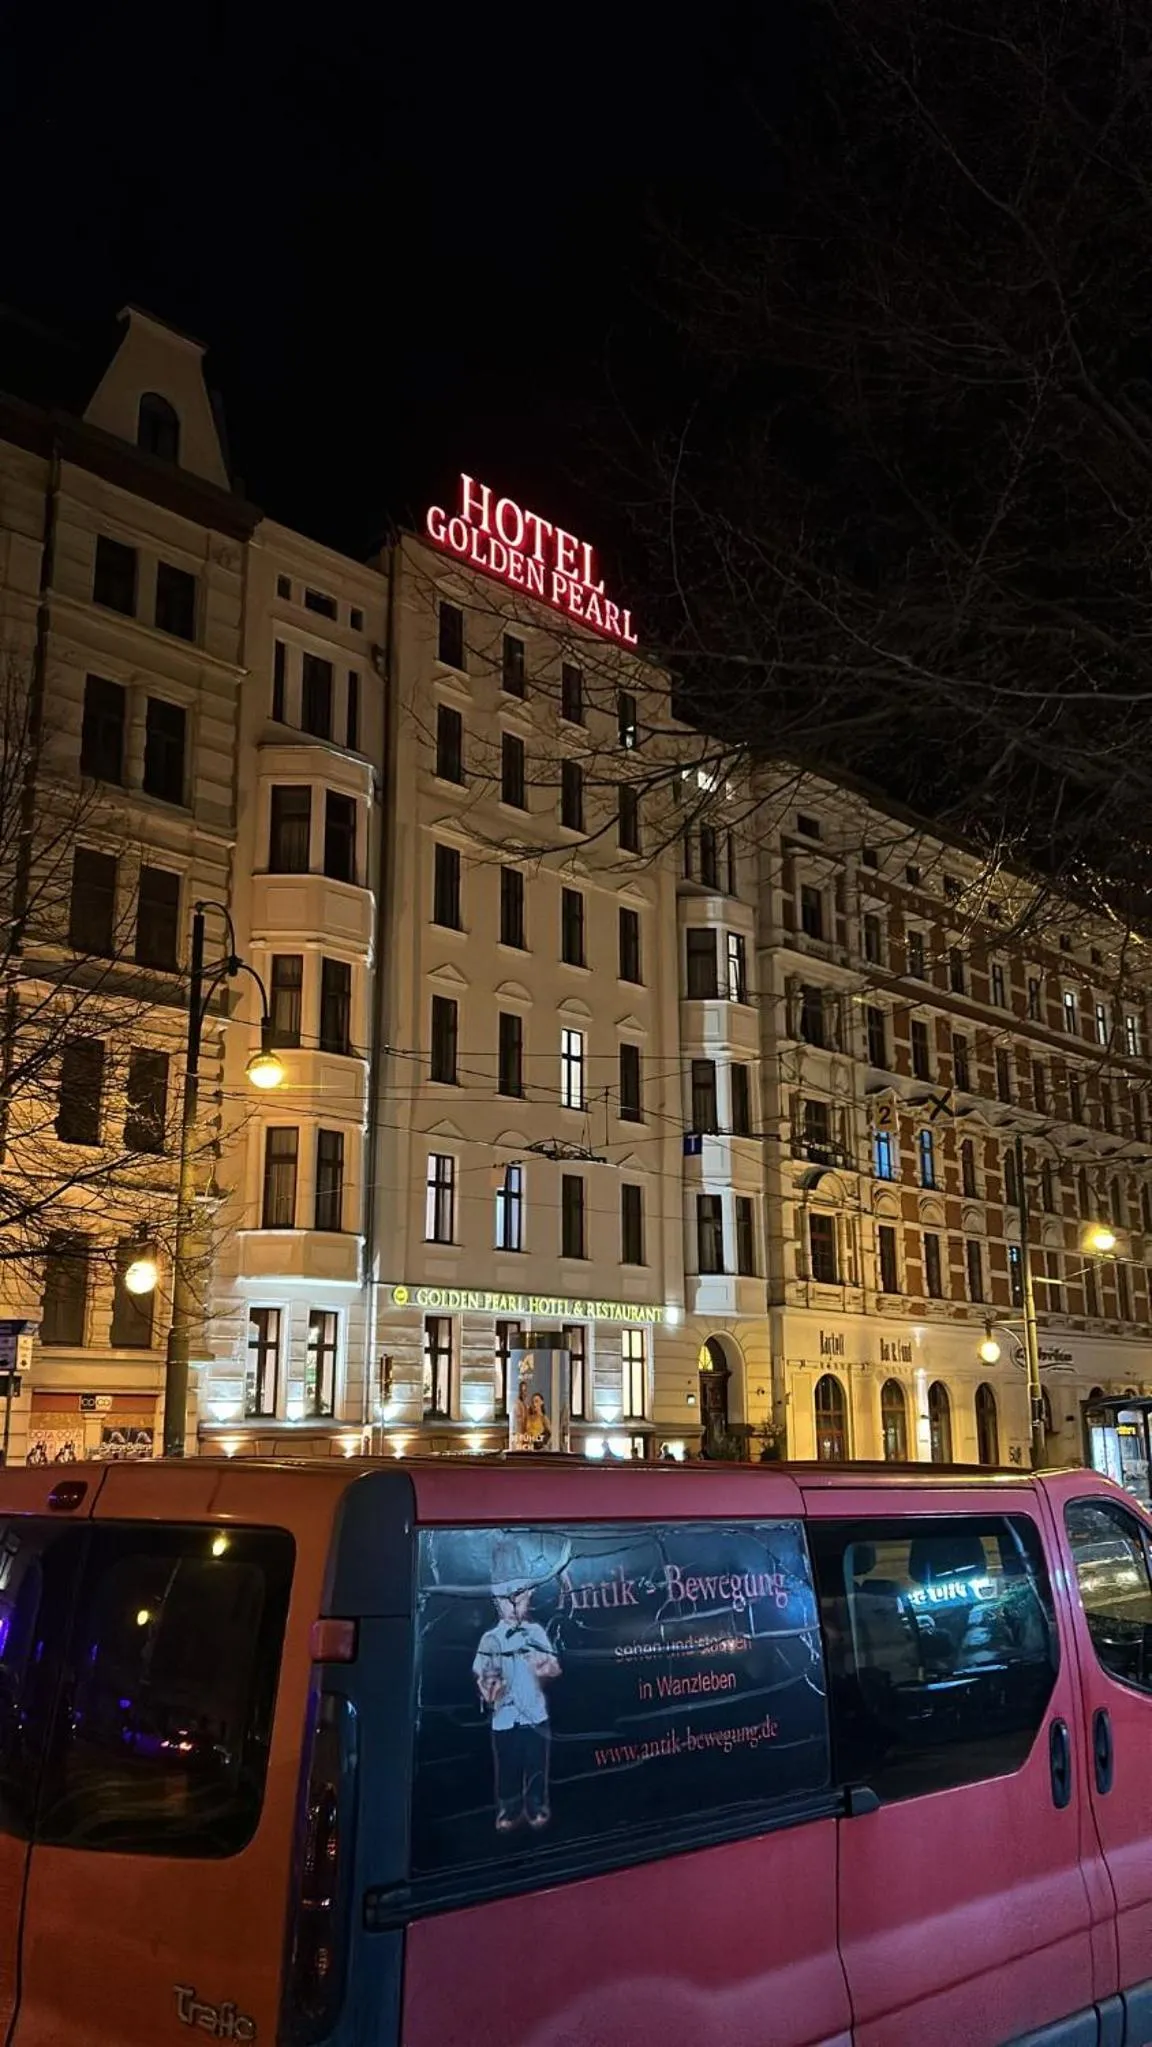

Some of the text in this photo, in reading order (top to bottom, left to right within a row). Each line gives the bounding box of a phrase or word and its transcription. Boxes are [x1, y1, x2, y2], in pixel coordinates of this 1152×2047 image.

[460, 472, 605, 595] HOTEL
[426, 505, 639, 644] GOLDEN PEARL
[416, 1288, 480, 1309] GOLDEN
[484, 1291, 526, 1312] PEARL
[528, 1296, 572, 1316] HOTEL
[573, 1300, 584, 1316] &
[586, 1301, 663, 1323] RESTAURANT
[664, 1563, 790, 1613] Bewegung
[638, 1669, 737, 1700] in Wanzleben
[594, 1712, 779, 1768] www.antik-bewegung.de
